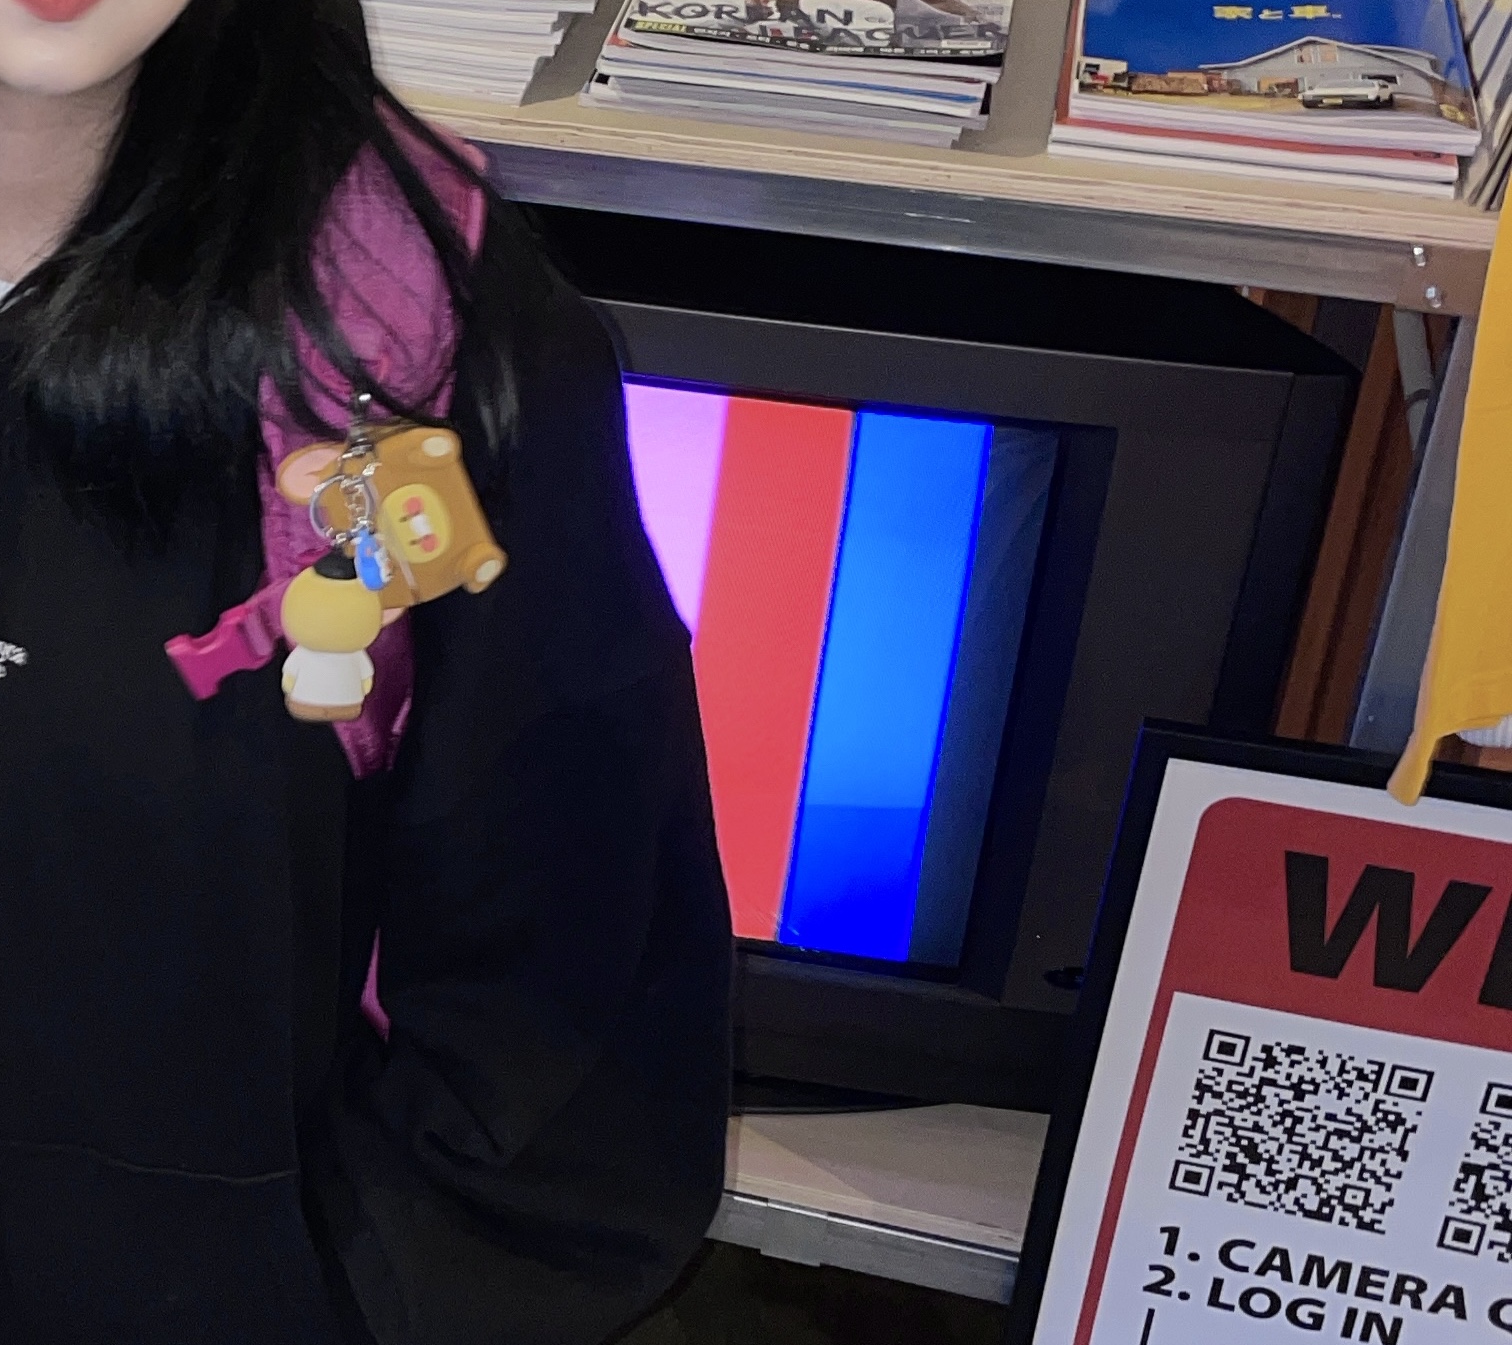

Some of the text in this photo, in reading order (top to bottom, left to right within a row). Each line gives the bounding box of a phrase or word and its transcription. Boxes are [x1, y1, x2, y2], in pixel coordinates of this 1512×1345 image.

[1141, 1264, 1192, 1302] 2.
[1206, 1276, 1327, 1332] LOG
[1158, 1225, 1202, 1263] 1.
[1217, 1238, 1469, 1322] CAMERA
